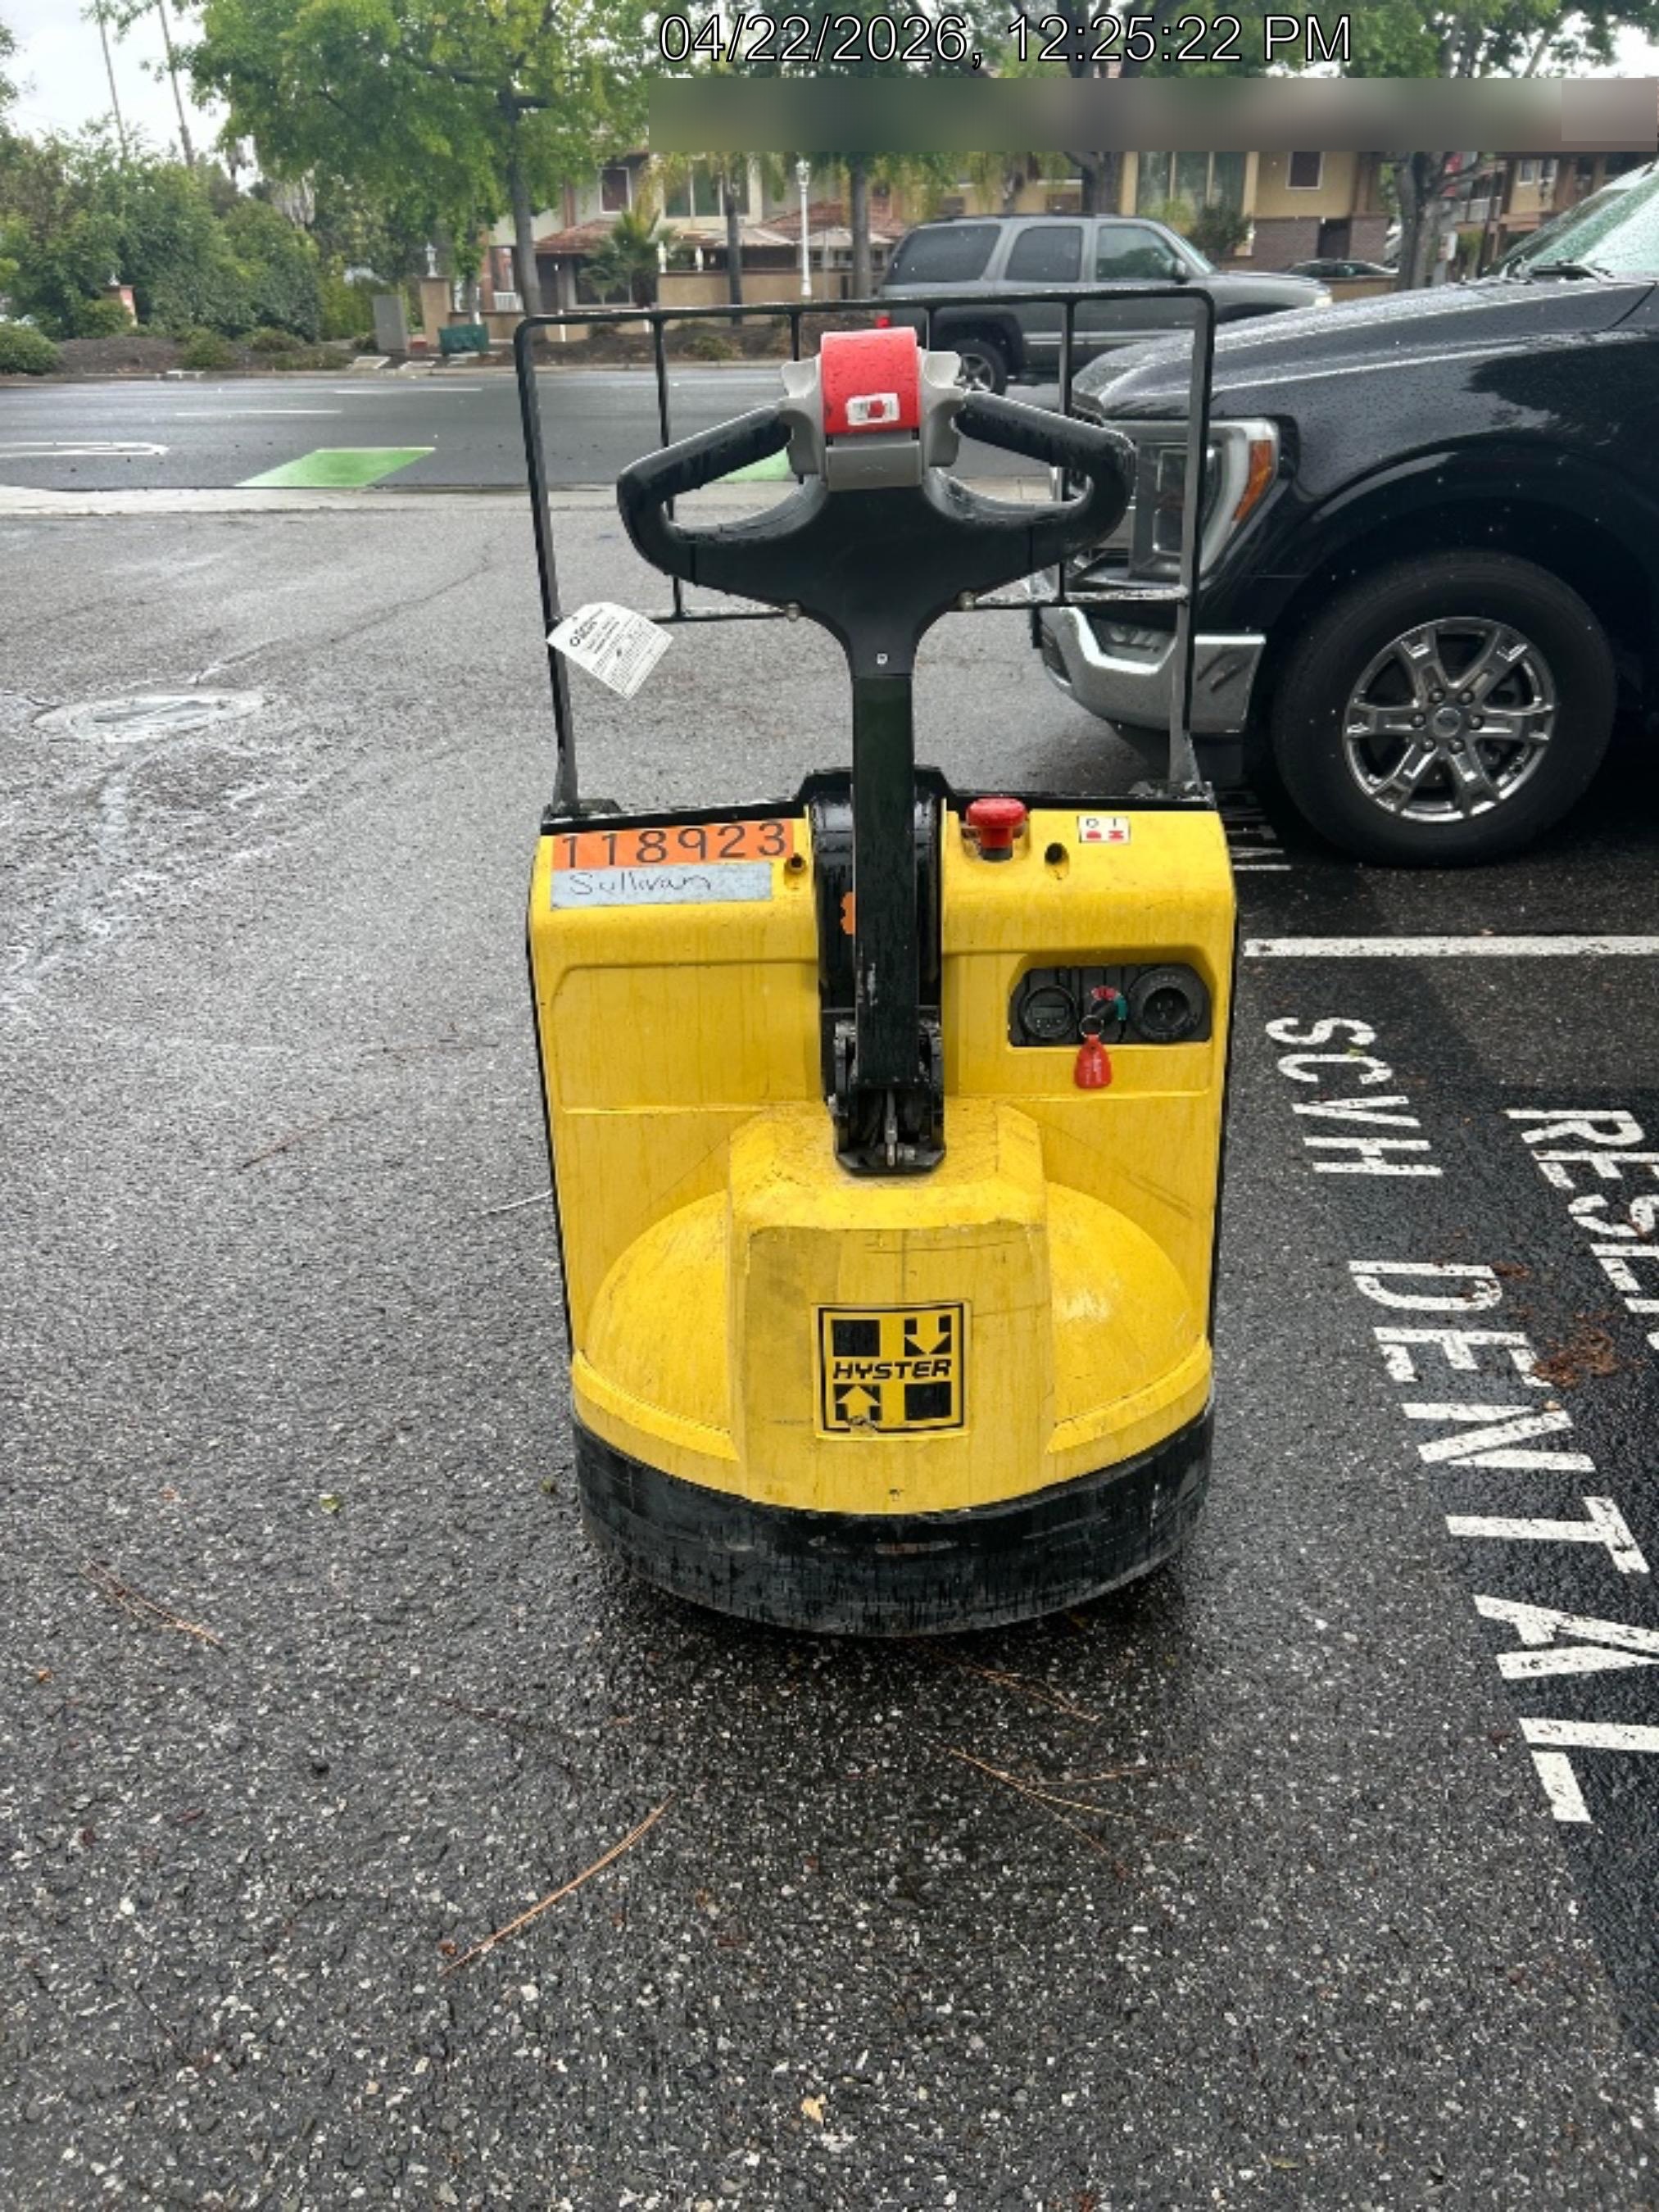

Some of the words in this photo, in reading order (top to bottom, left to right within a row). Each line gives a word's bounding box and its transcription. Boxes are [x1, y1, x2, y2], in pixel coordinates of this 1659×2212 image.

[562, 820, 786, 868] 118923
[569, 870, 713, 896] Sullivan
[1265, 1017, 1444, 1176] SCVH
[832, 1358, 952, 1380] HYSTER
[1348, 1259, 1659, 1824] DENTAL
